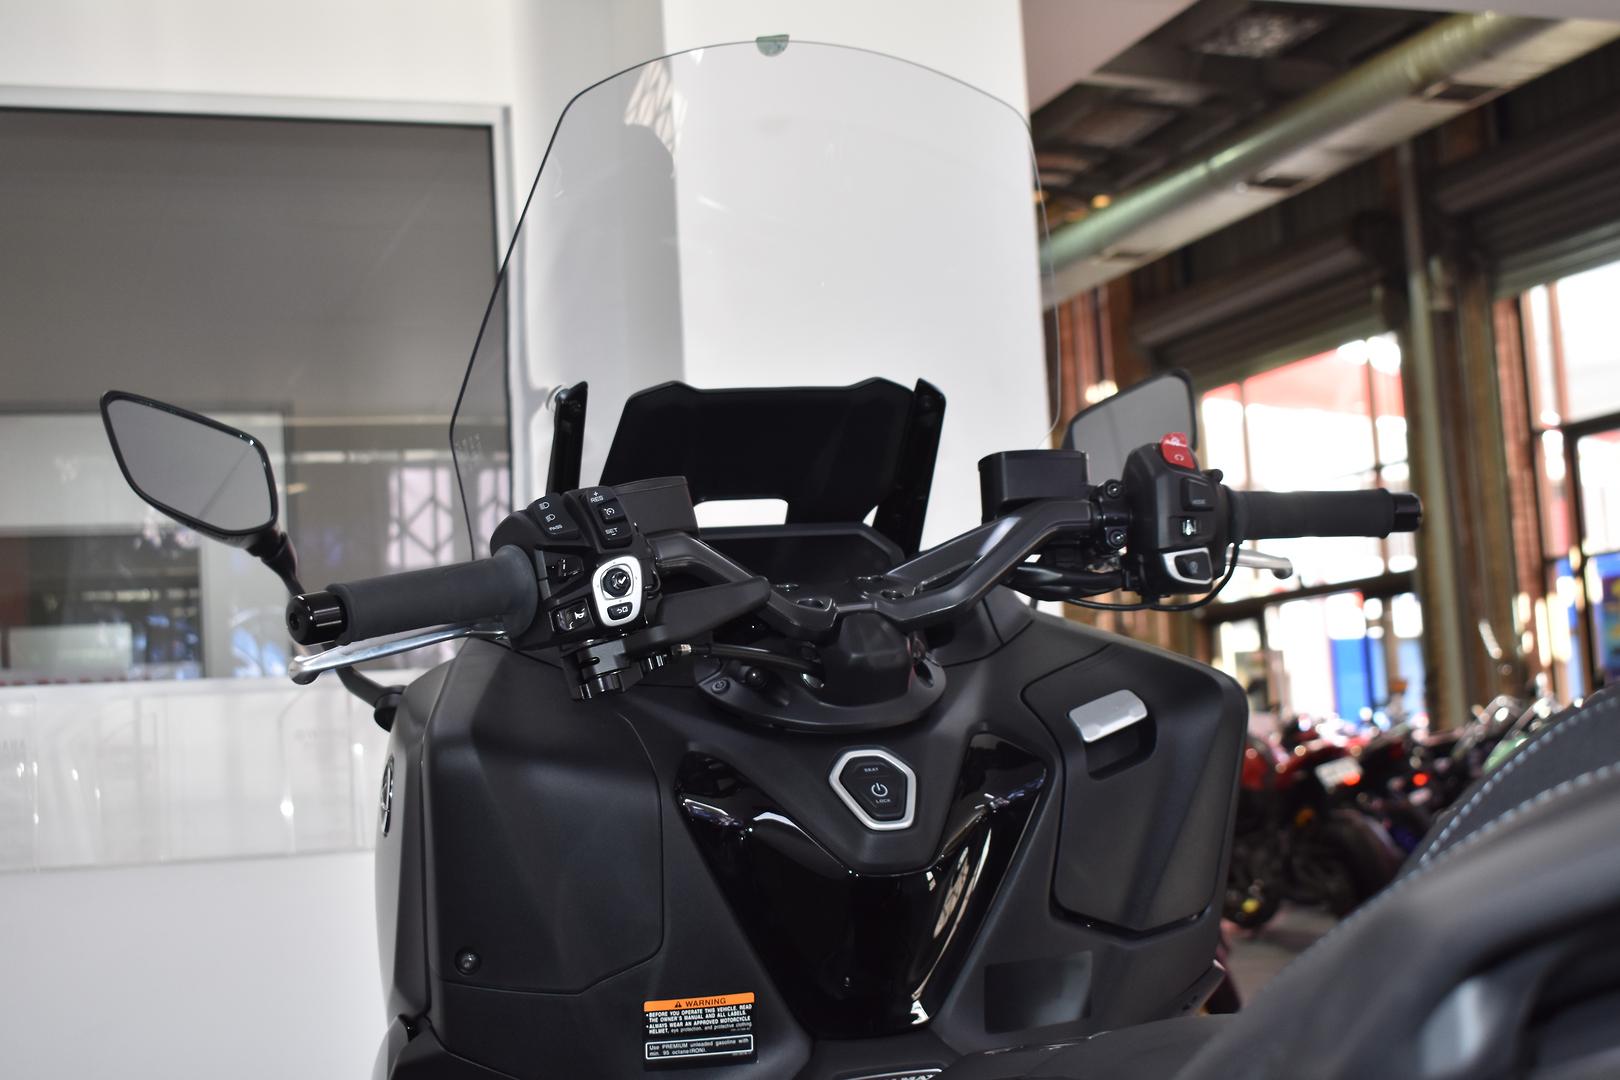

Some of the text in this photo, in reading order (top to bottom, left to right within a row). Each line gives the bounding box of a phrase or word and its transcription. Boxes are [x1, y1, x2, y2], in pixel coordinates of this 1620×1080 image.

[686, 998, 726, 1008] WARNING
[681, 1008, 703, 1016] OPERATE
[693, 1018, 719, 1026] APPROVED
[720, 1015, 751, 1023] MOTORCYCLE
[662, 1042, 688, 1050] PREMIUM
[690, 1040, 713, 1048] unleaded
[715, 1039, 736, 1047] gasoline
